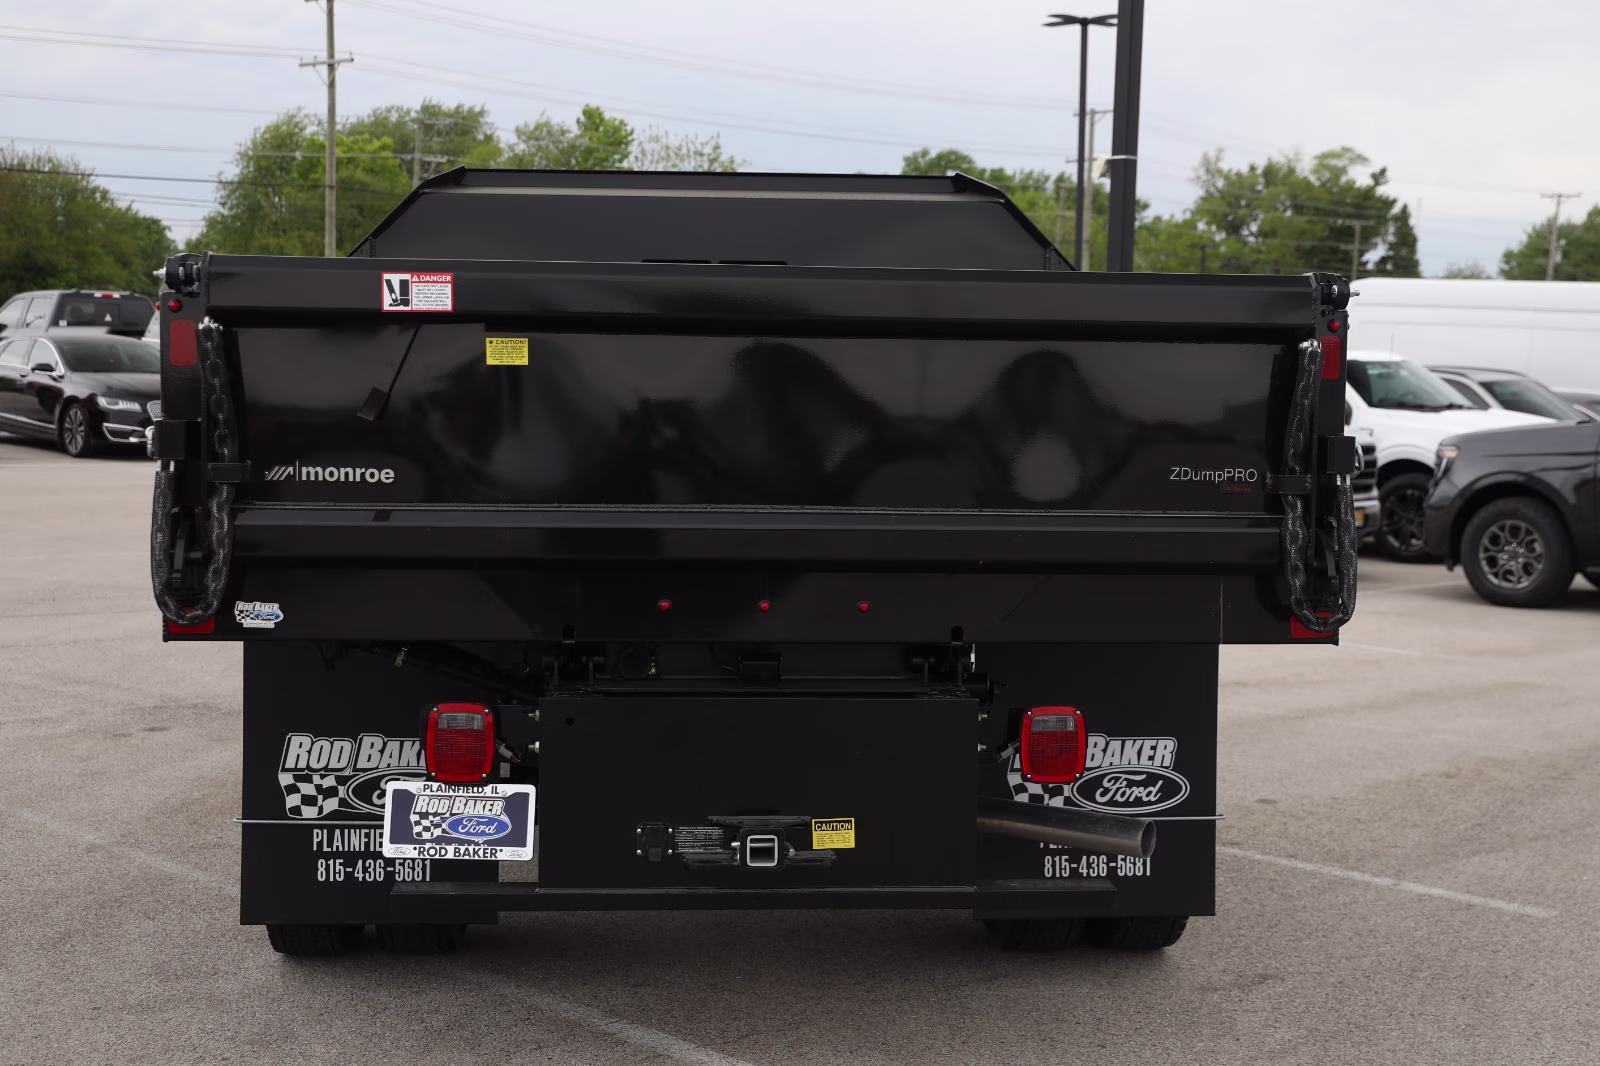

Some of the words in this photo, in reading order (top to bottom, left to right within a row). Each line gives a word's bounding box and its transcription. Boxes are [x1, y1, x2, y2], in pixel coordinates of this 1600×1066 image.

[301, 466, 395, 483] monroe
[1169, 467, 1258, 484] ZDumpPRO
[284, 735, 353, 769] ROD
[356, 735, 427, 768] BAK
[1086, 736, 1174, 767] BAKER
[422, 783, 488, 795] PLAINFIELD,
[491, 785, 500, 795] IL
[1095, 773, 1163, 802] Ford
[415, 796, 450, 814] ROD
[452, 796, 504, 815] BAKER
[458, 816, 498, 834] Ford
[815, 822, 852, 831] CAUTION
[313, 828, 384, 852] PLAINFIE
[317, 858, 431, 882] 815-436-5681
[1044, 855, 1151, 877] 815-436-5681
